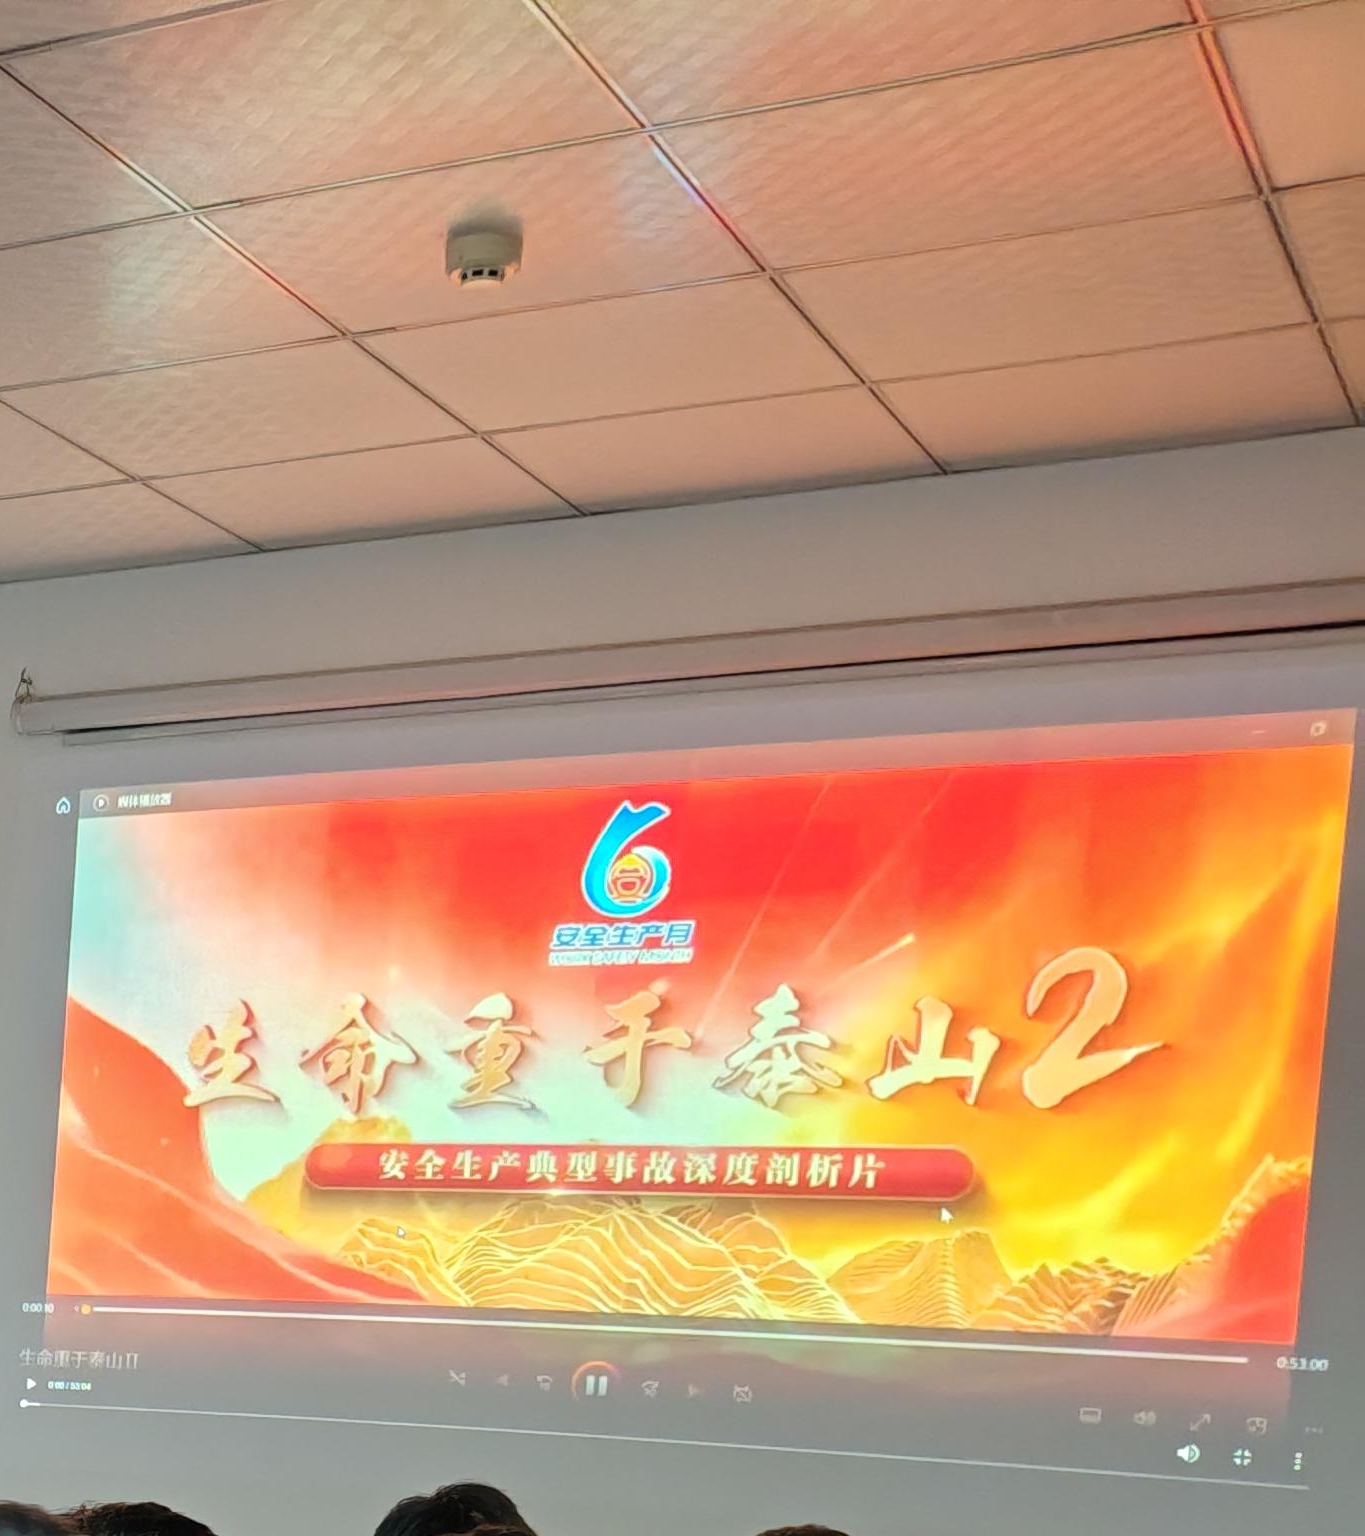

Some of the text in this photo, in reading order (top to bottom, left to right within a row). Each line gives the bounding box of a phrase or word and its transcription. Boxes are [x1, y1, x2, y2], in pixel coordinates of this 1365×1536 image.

[551, 920, 696, 949] 安全生产月
[377, 1149, 886, 1191] 安全生产典型事故深度剖析片
